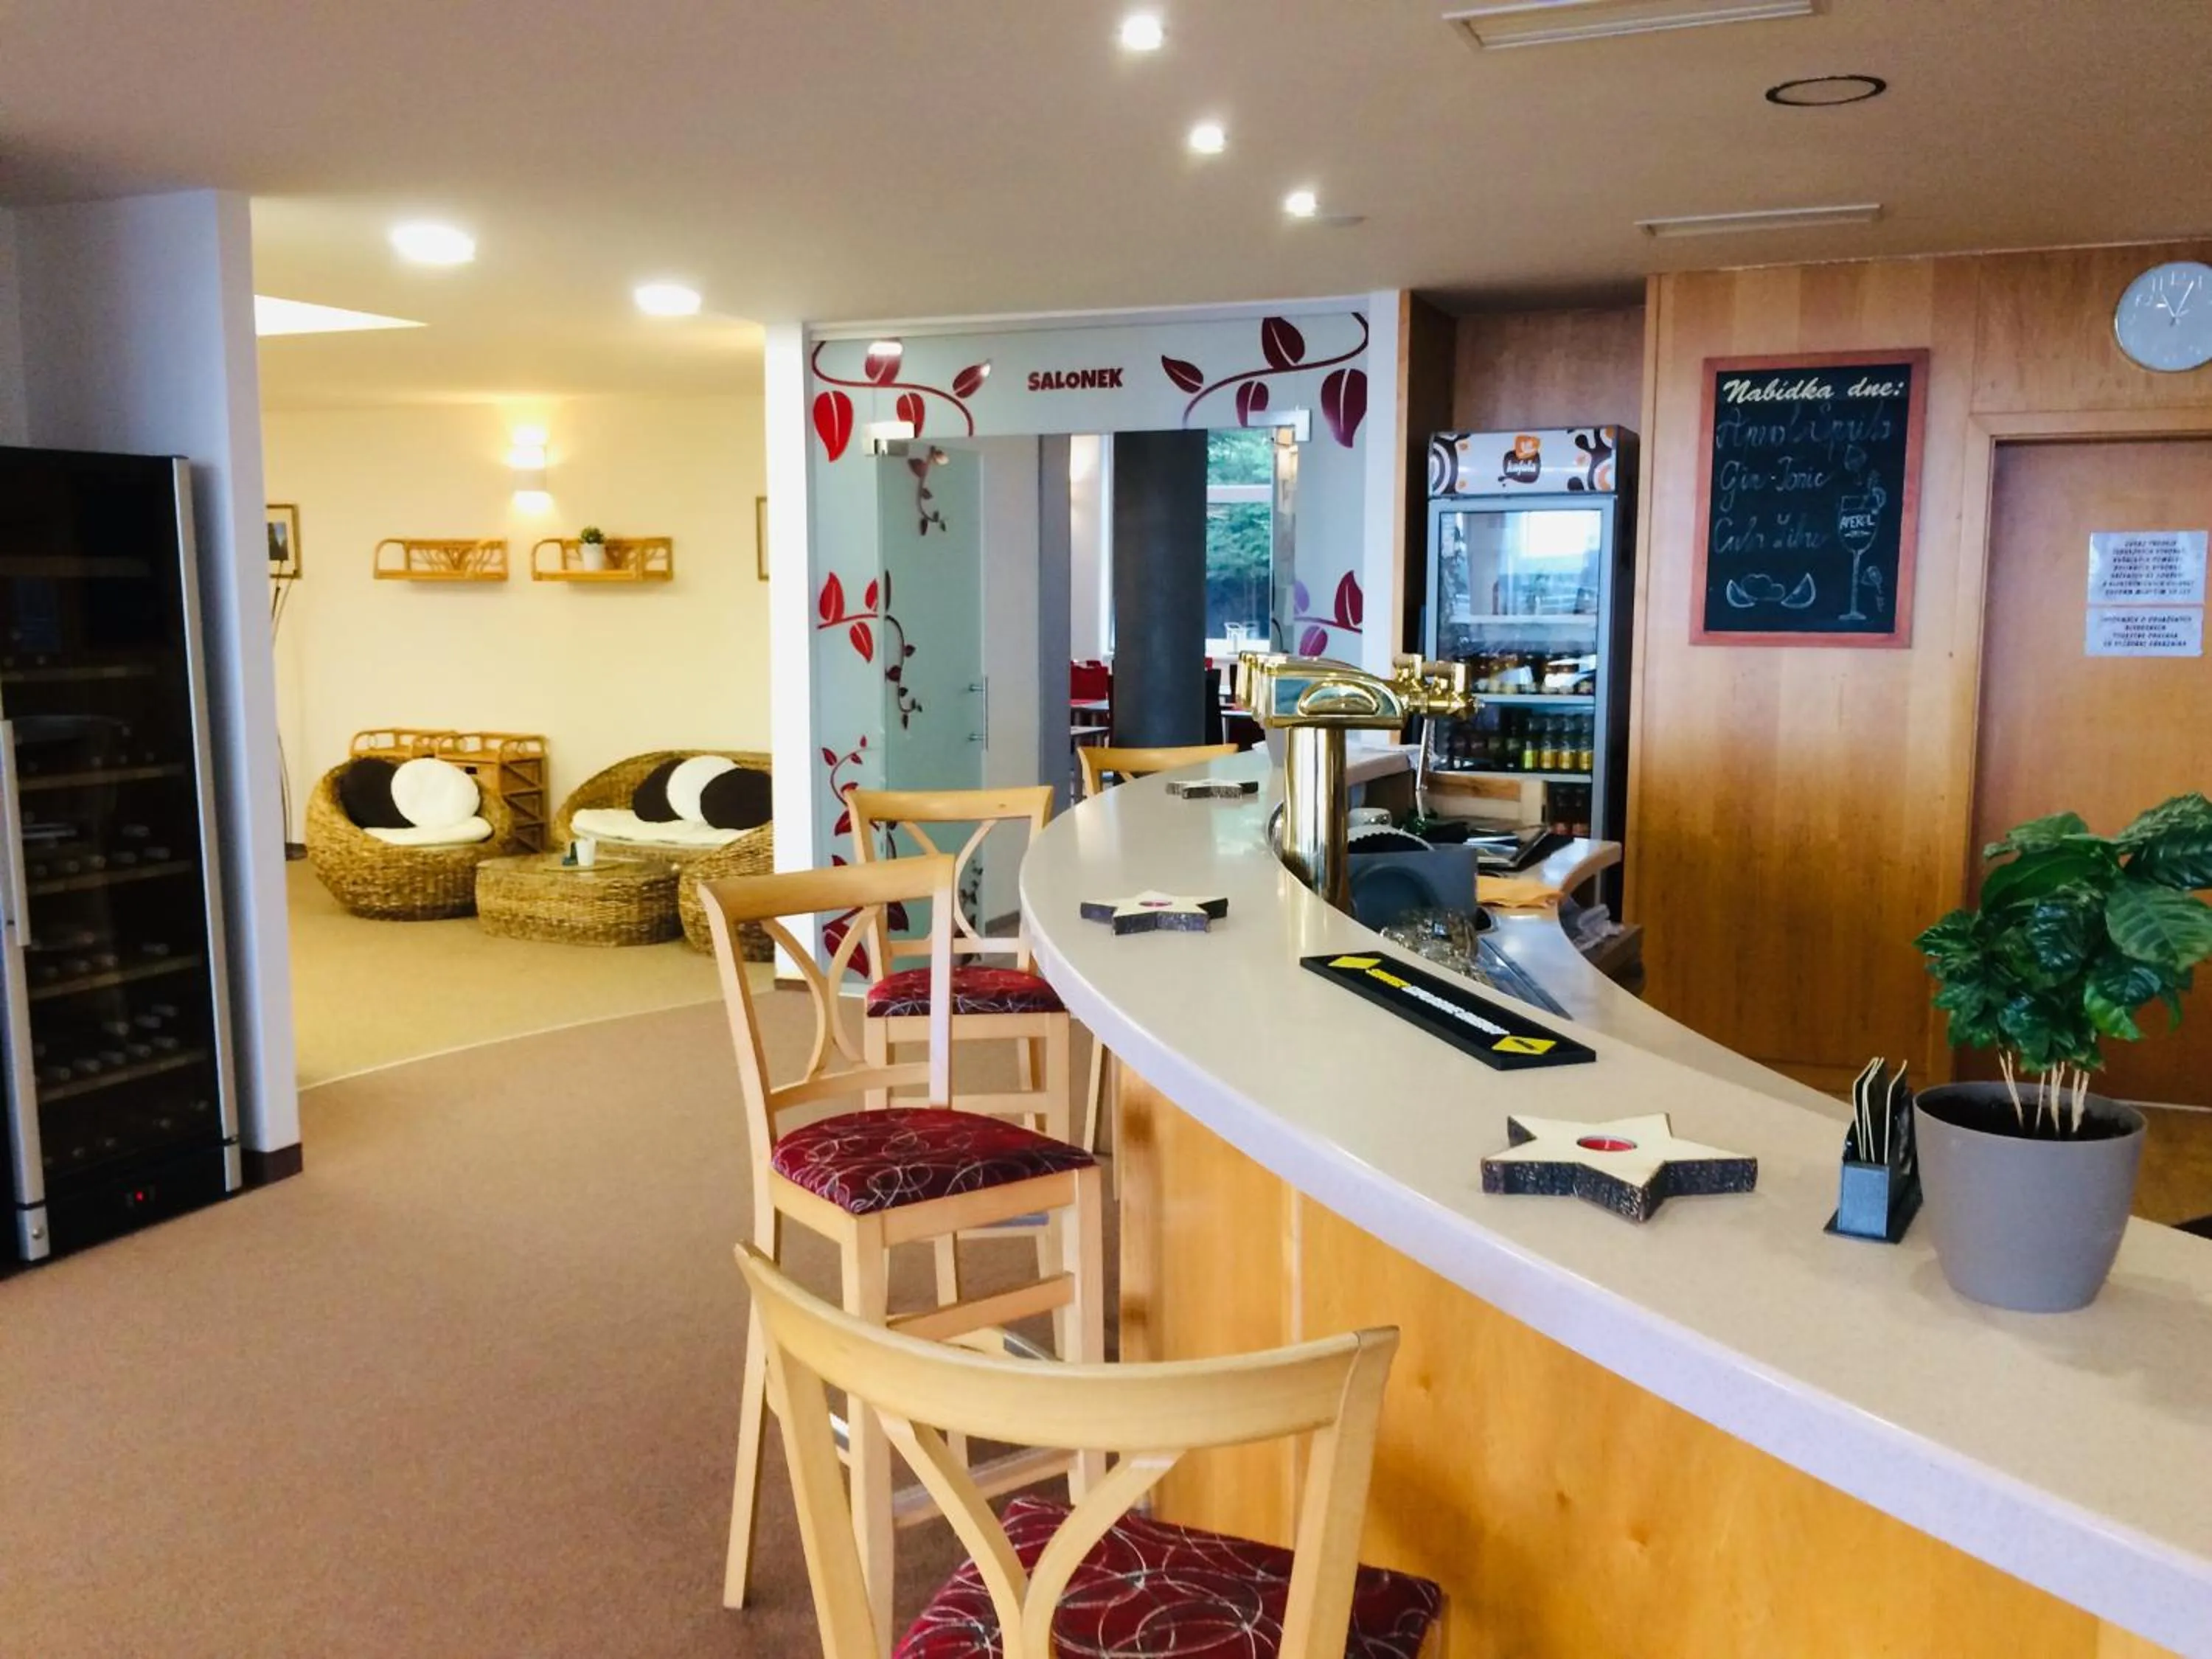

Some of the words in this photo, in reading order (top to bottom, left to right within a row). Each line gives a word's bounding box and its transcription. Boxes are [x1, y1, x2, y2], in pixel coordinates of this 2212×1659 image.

[1027, 368, 1123, 392] SALONEK
[1722, 377, 1835, 403] Nabídka
[1848, 377, 1905, 397] dne:
